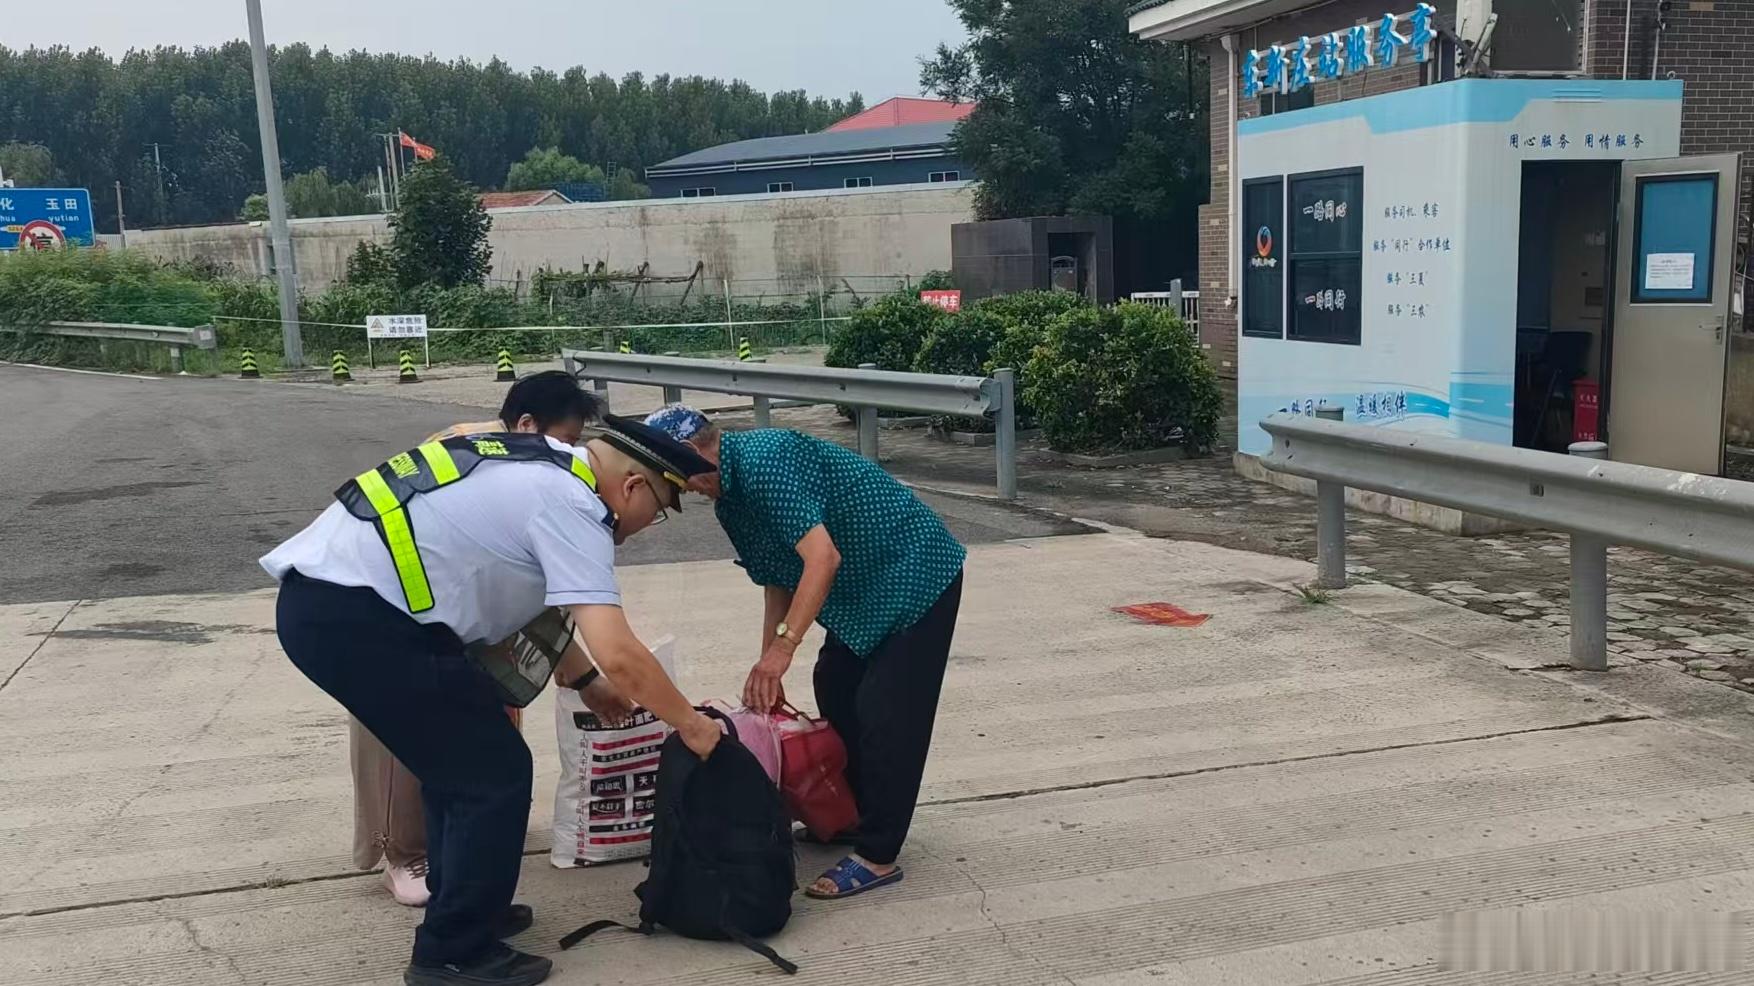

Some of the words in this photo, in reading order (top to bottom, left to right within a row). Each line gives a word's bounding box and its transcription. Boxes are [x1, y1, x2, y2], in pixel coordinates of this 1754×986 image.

[1509, 133, 1570, 149] 用心服务
[1584, 133, 1645, 150] 用情服务
[45, 198, 78, 210] 玉田
[48, 214, 80, 222] yutian
[389, 317, 422, 325] 水深危险
